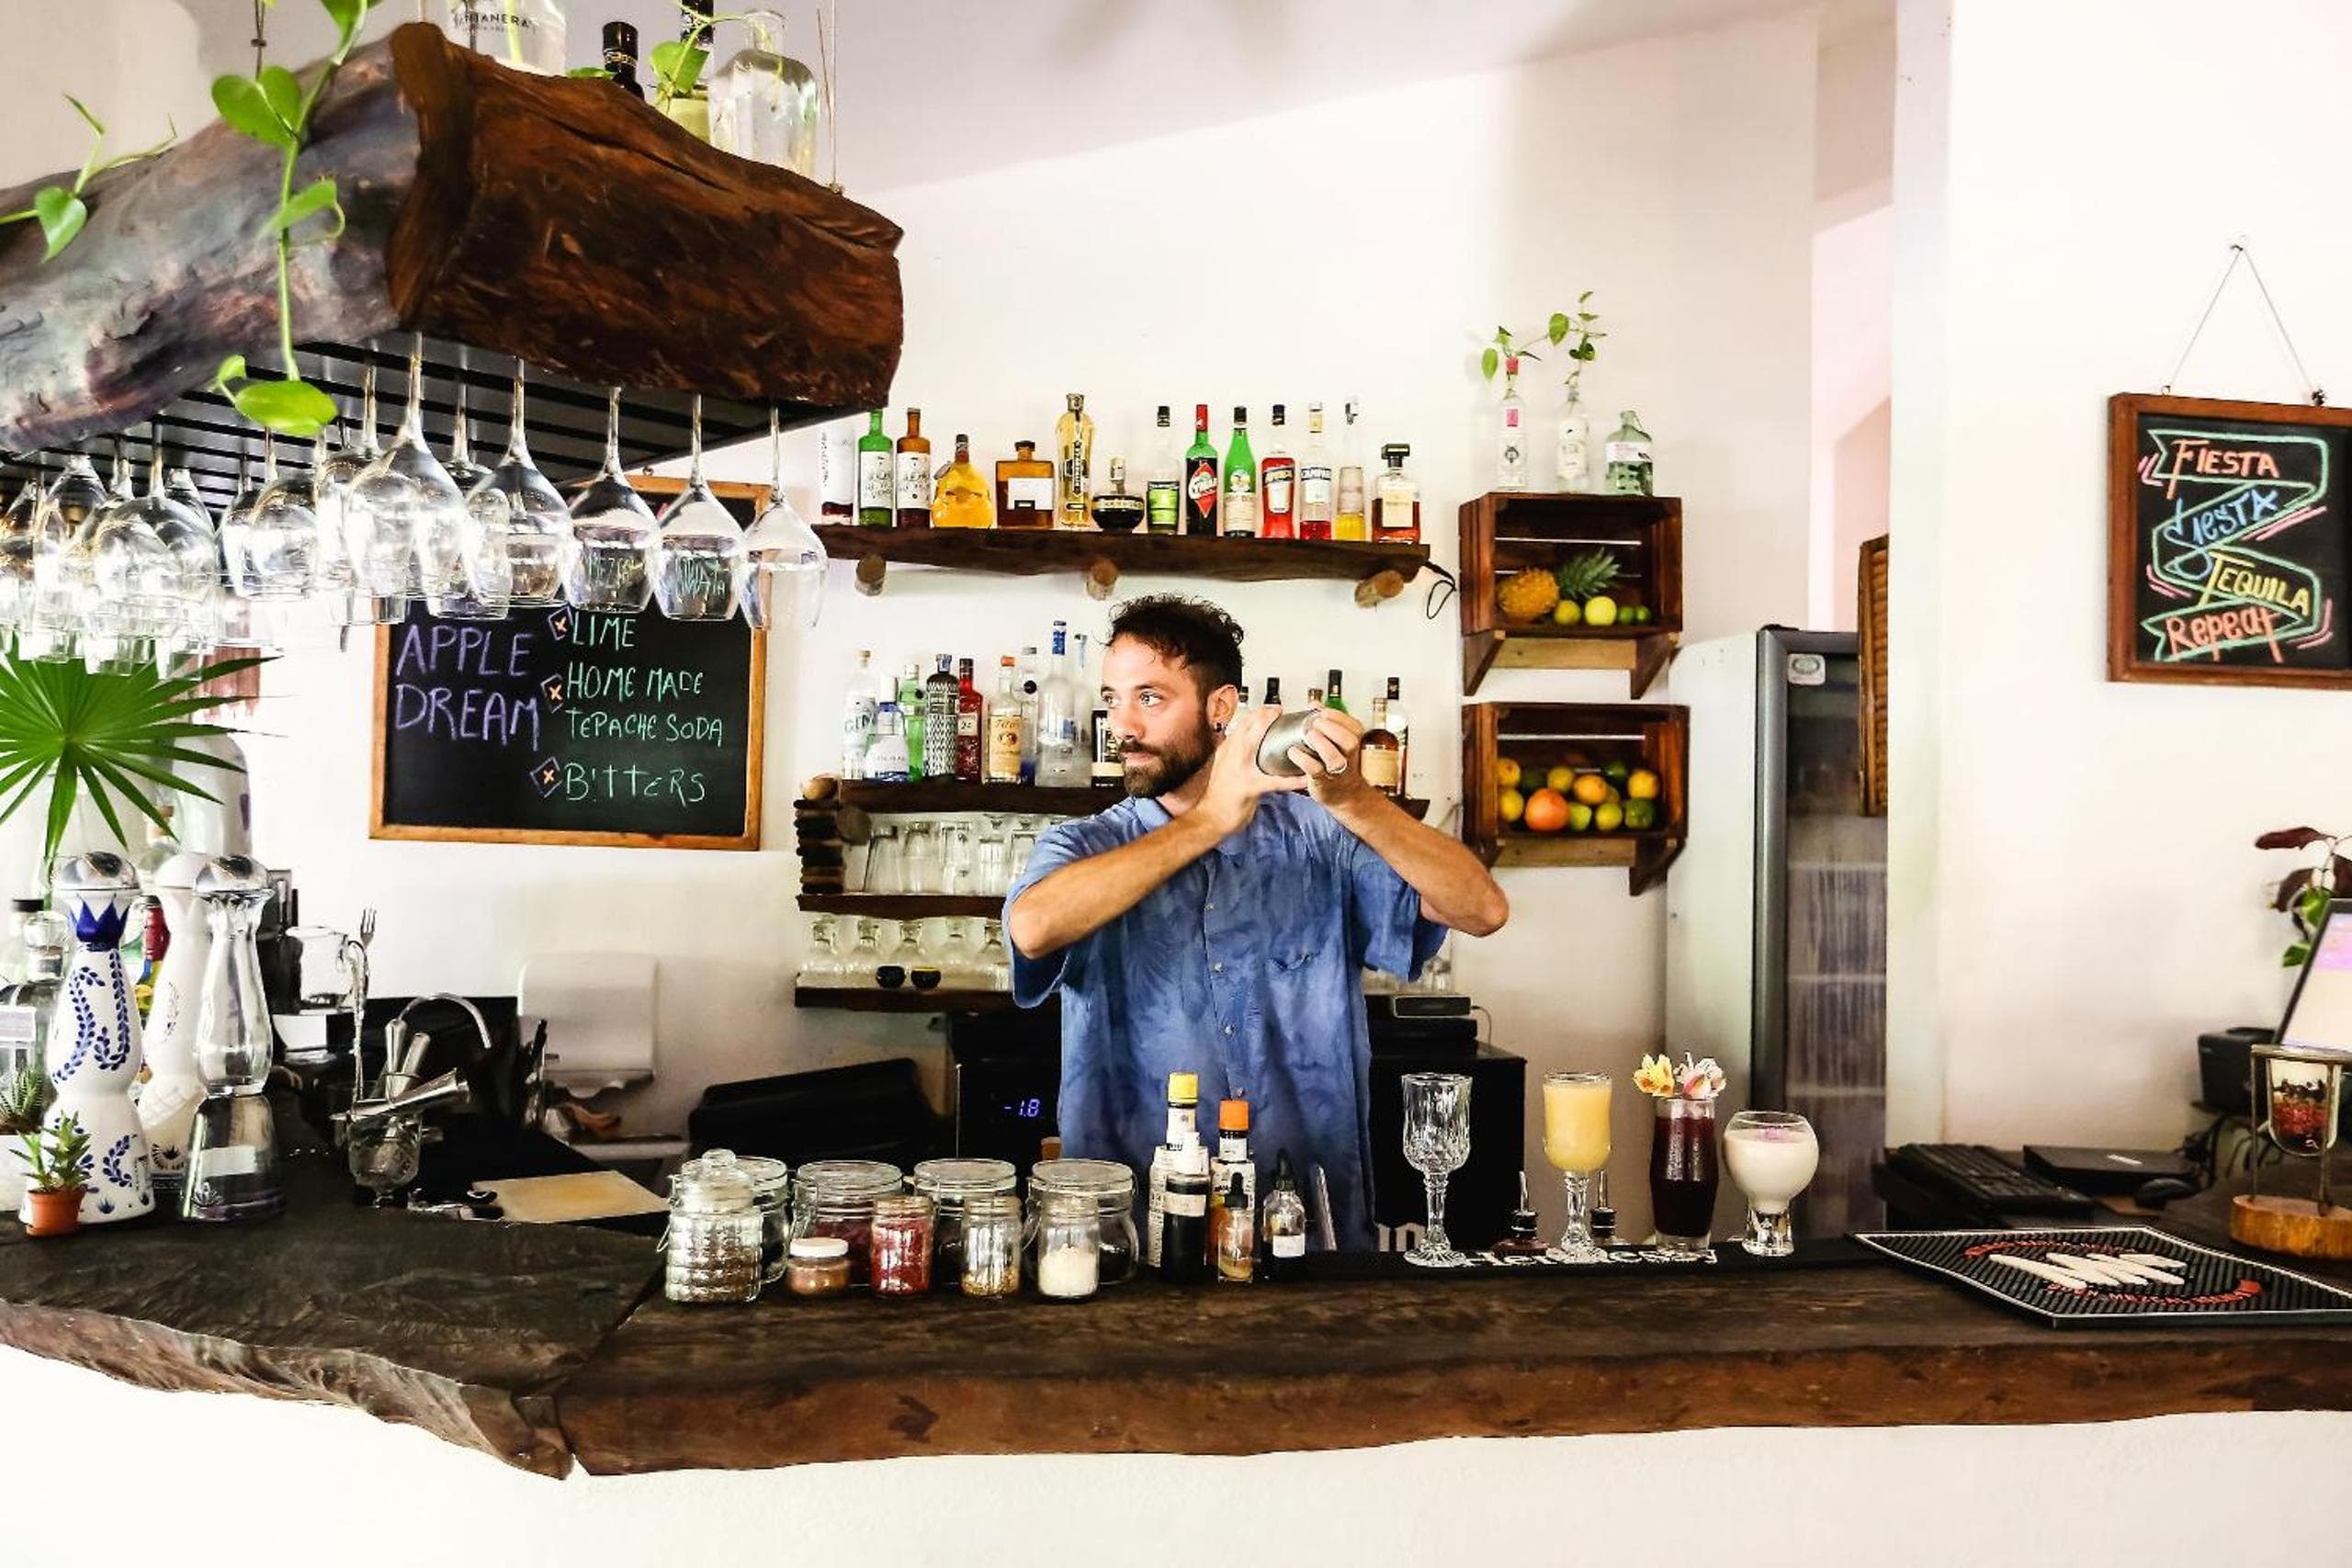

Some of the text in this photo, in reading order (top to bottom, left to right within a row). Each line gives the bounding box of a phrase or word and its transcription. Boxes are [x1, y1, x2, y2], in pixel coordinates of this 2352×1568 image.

[2166, 439, 2280, 500] FIESTA
[2198, 551, 2311, 617] TEQUILA
[395, 624, 533, 677] APPLE
[571, 615, 637, 650] LIME
[567, 661, 636, 702] HOME
[395, 683, 540, 751] DREAM
